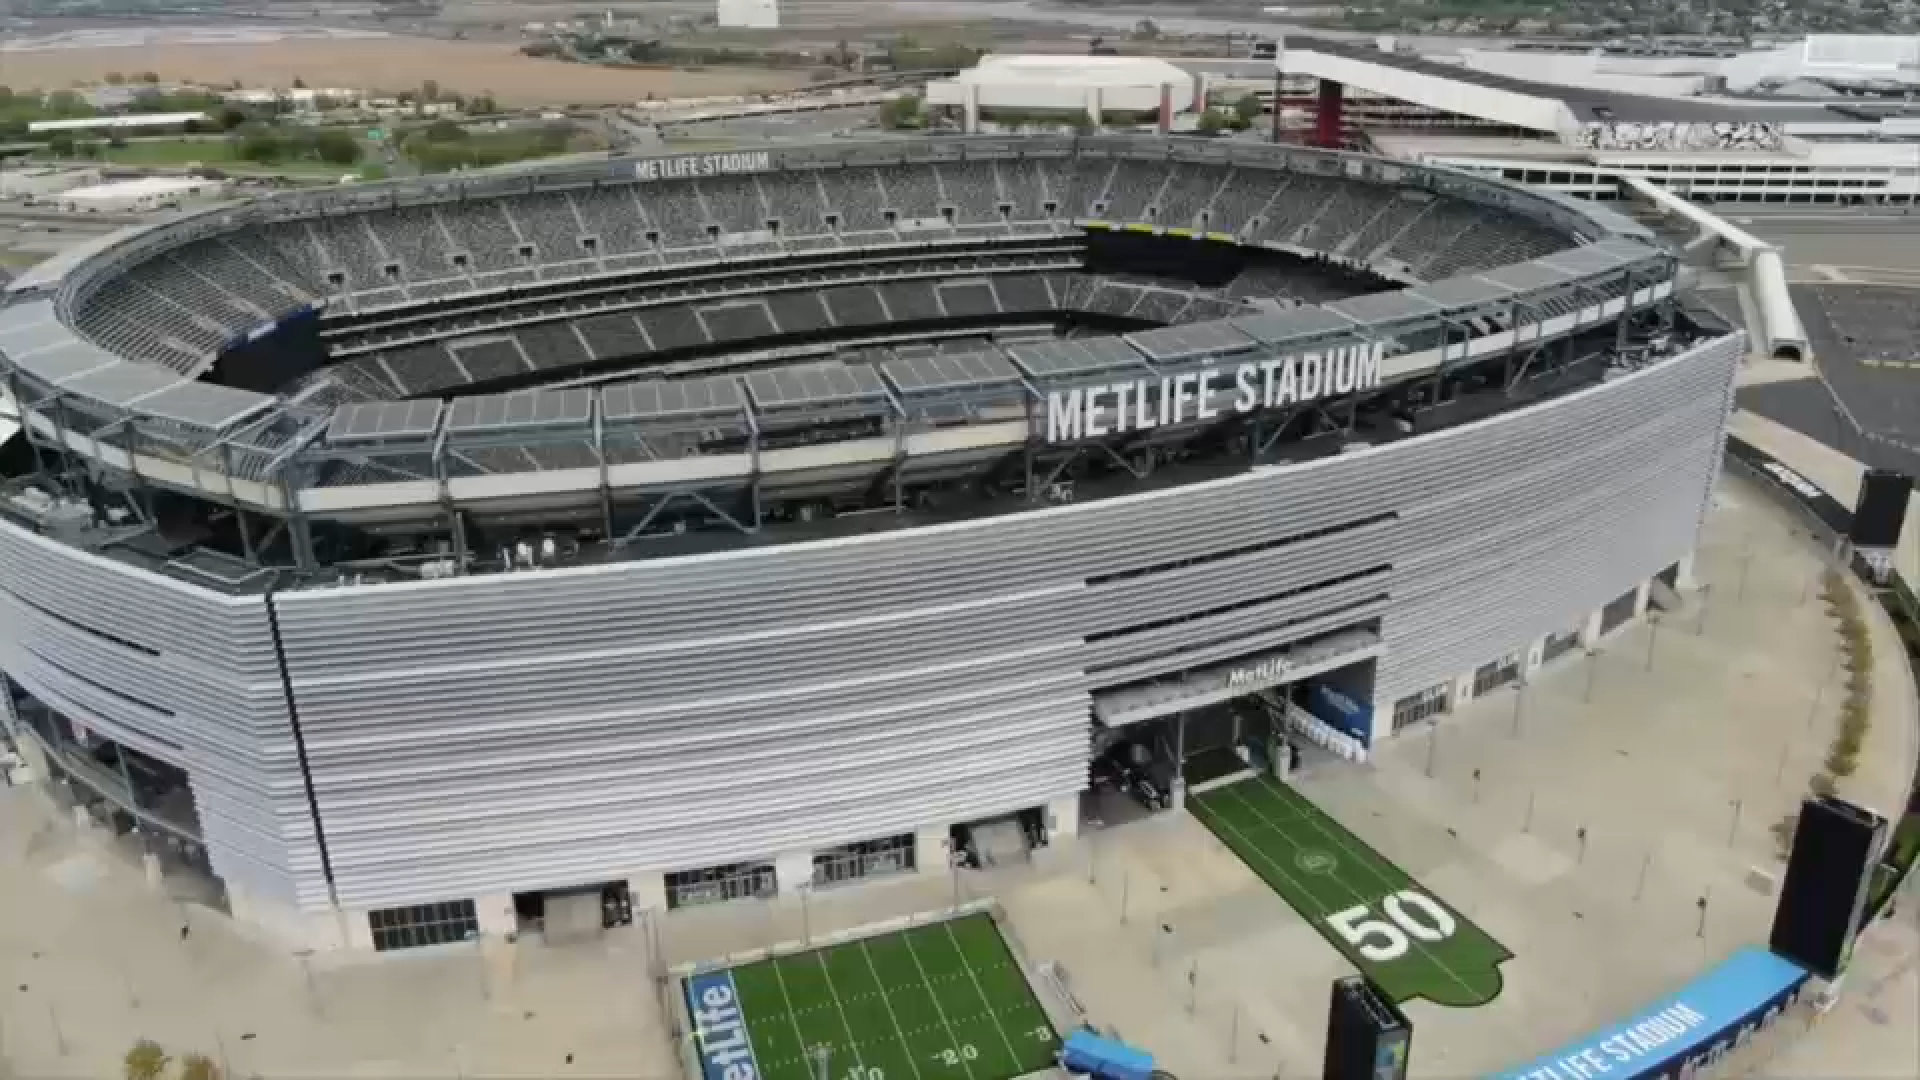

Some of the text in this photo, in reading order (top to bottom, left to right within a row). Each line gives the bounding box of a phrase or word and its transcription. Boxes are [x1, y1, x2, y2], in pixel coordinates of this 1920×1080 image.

[635, 151, 769, 180] METLIFE STADIUM
[1048, 341, 1383, 442] METLIFE STADIUM
[1228, 658, 1296, 686] MetLife
[1326, 889, 1456, 961] 50
[1600, 1002, 1704, 1062] STADIUM
[942, 1044, 979, 1067] 20
